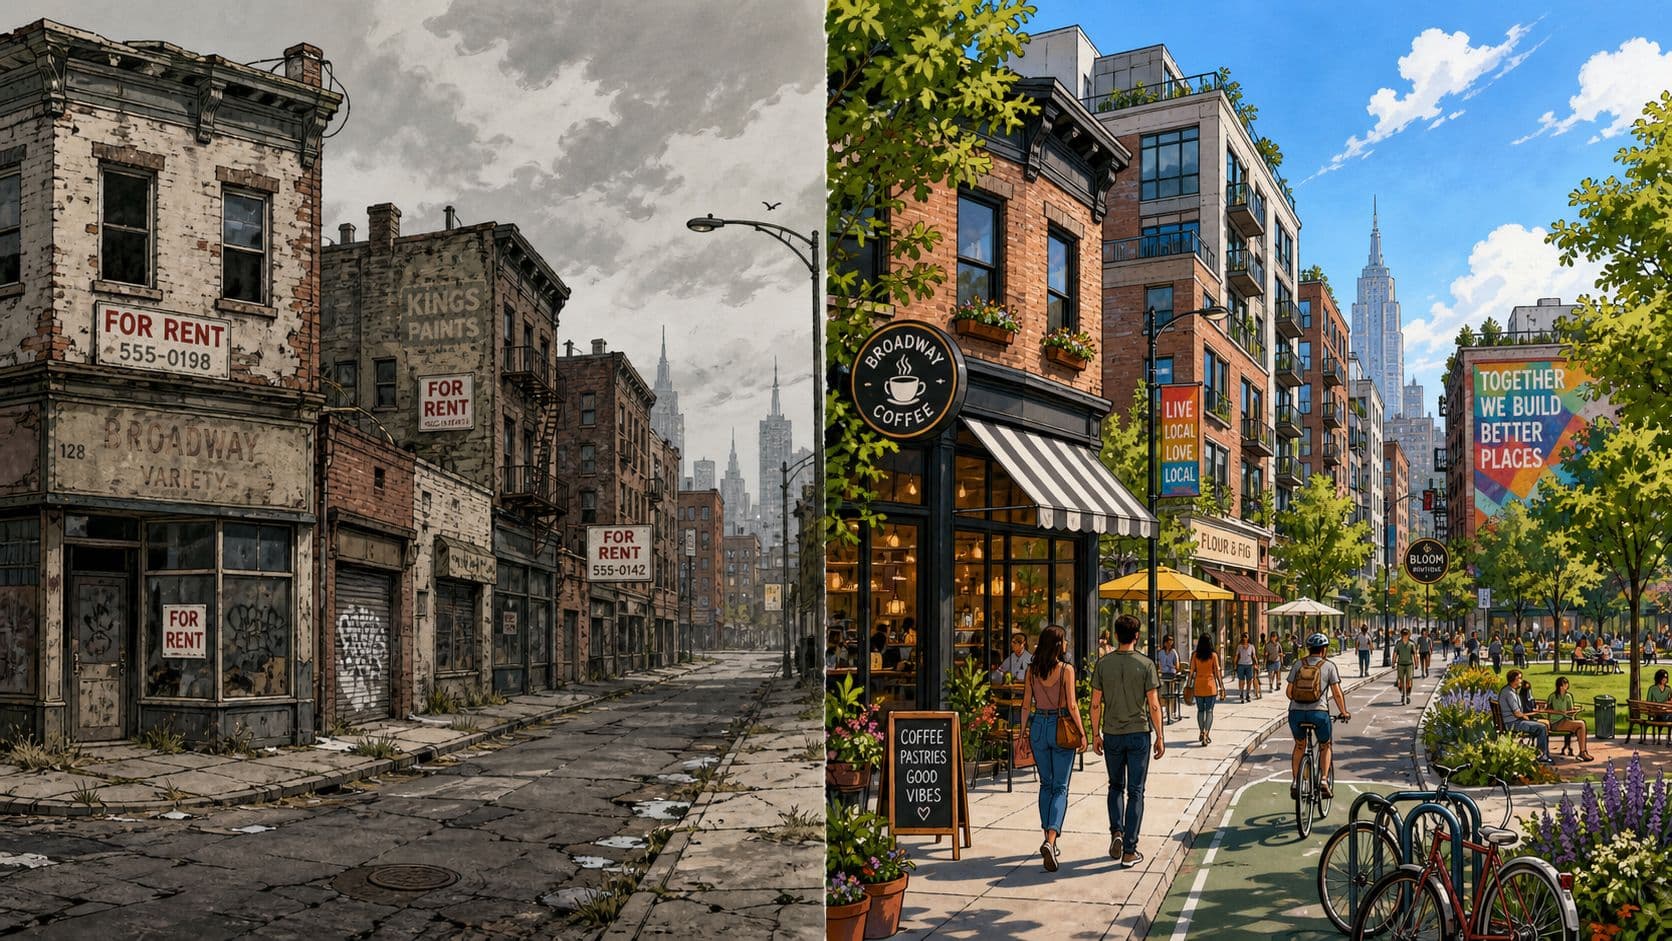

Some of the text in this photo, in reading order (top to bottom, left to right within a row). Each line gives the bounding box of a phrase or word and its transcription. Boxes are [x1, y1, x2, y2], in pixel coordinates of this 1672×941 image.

[407, 287, 481, 316] KINGS
[105, 309, 225, 348] FOR RENT
[408, 317, 481, 341] PAINTS
[120, 342, 211, 370] 555-0198
[864, 334, 944, 369] BROADWAY
[1480, 368, 1565, 391] TOGETHER
[428, 380, 463, 397] FOR
[424, 399, 469, 417] RENT
[873, 402, 934, 427] COFFEE
[1166, 401, 1193, 418] LIVE
[1481, 395, 1561, 417] WE BUILD
[104, 417, 259, 462] BROADWAY
[1165, 424, 1196, 440] LOCAL
[1481, 421, 1543, 443] BETTER
[60, 443, 86, 460] 128
[1166, 445, 1193, 461] LOVE
[1481, 447, 1543, 469] PLACES
[140, 465, 226, 490] VARIETY
[1165, 467, 1196, 482] LOCAL
[604, 530, 634, 543] FOR
[599, 546, 641, 560] RENT
[1201, 532, 1251, 559] FLOUR & FIG
[1409, 554, 1444, 564] BLOOM
[593, 564, 646, 576] 555-0142
[170, 610, 198, 627] FOR
[166, 631, 204, 649] RENT
[900, 729, 944, 745] COFFEE
[900, 749, 947, 765] PASTRIES
[906, 769, 938, 784] GOOD
[906, 787, 942, 803] VIBES
